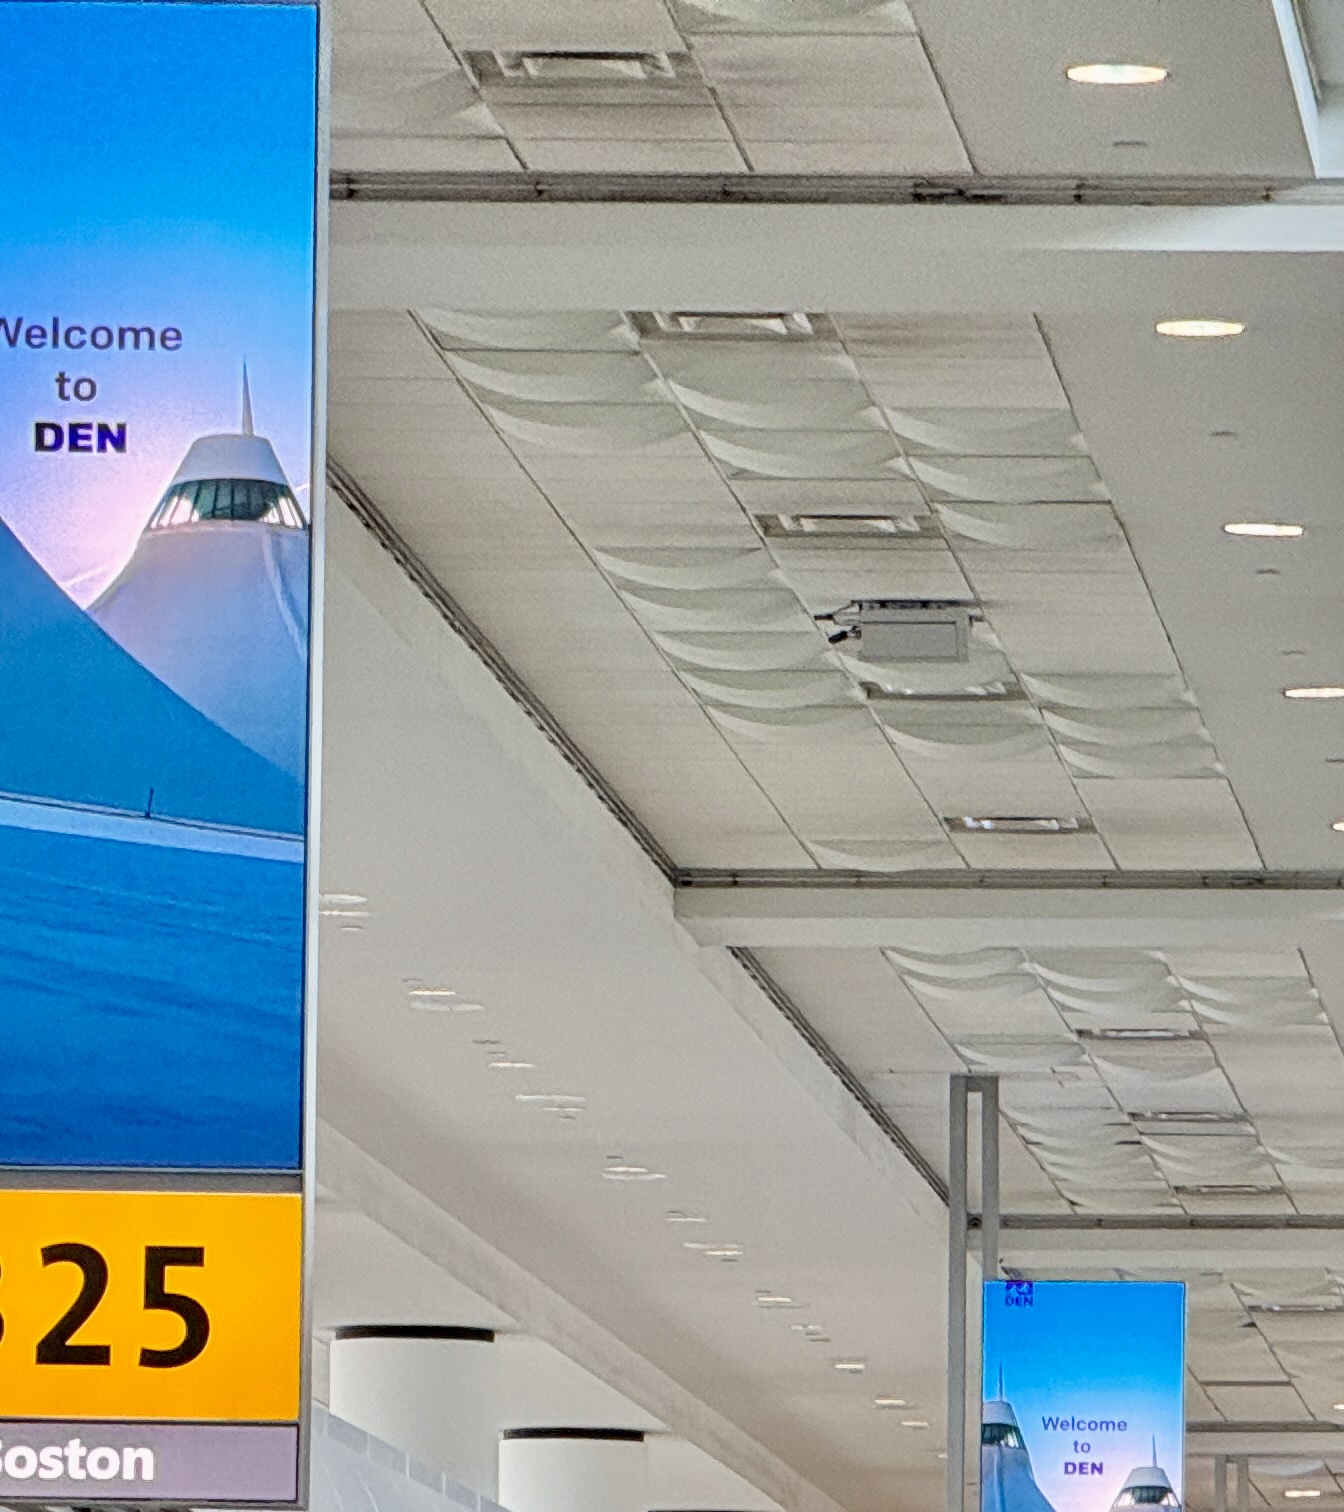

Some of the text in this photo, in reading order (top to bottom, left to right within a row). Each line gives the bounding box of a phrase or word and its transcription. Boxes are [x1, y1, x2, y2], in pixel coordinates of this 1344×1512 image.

[55, 371, 98, 402] to
[33, 421, 128, 453] DEN
[0, 1242, 211, 1369] 25
[1004, 1294, 1035, 1308] DEN
[1041, 1414, 1128, 1433] Welcome
[1072, 1438, 1092, 1454] to
[0, 1437, 156, 1481] oston
[1063, 1461, 1104, 1476] DEN
